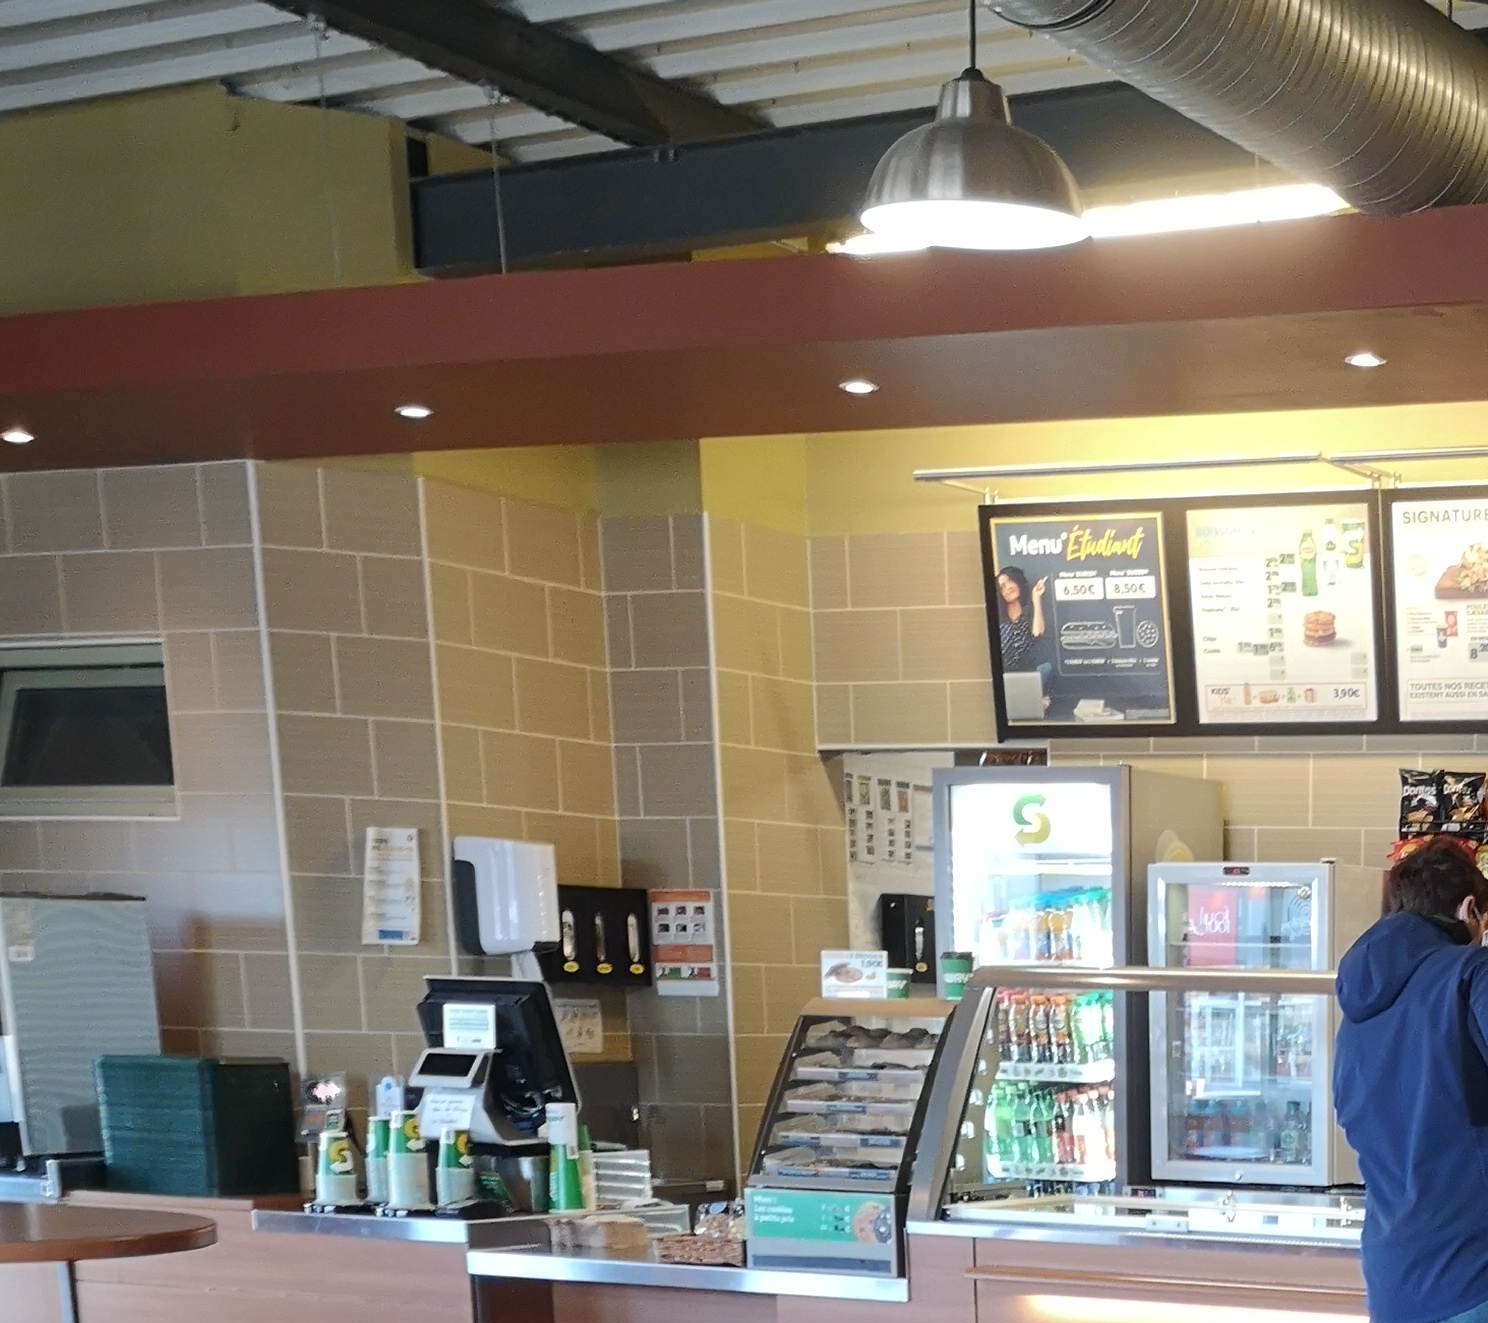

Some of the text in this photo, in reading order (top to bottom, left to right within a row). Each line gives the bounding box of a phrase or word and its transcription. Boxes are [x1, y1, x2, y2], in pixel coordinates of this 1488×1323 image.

[1066, 524, 1146, 561] Étudiant
[1063, 585, 1096, 596] 6,50€
[1114, 583, 1146, 596] 8,50€
[1410, 683, 1443, 691] TOUTES
[1333, 688, 1360, 700] 3,90€
[1410, 691, 1444, 699] EXISTENT
[1403, 785, 1437, 796] Doritos
[767, 1206, 793, 1214] cookies
